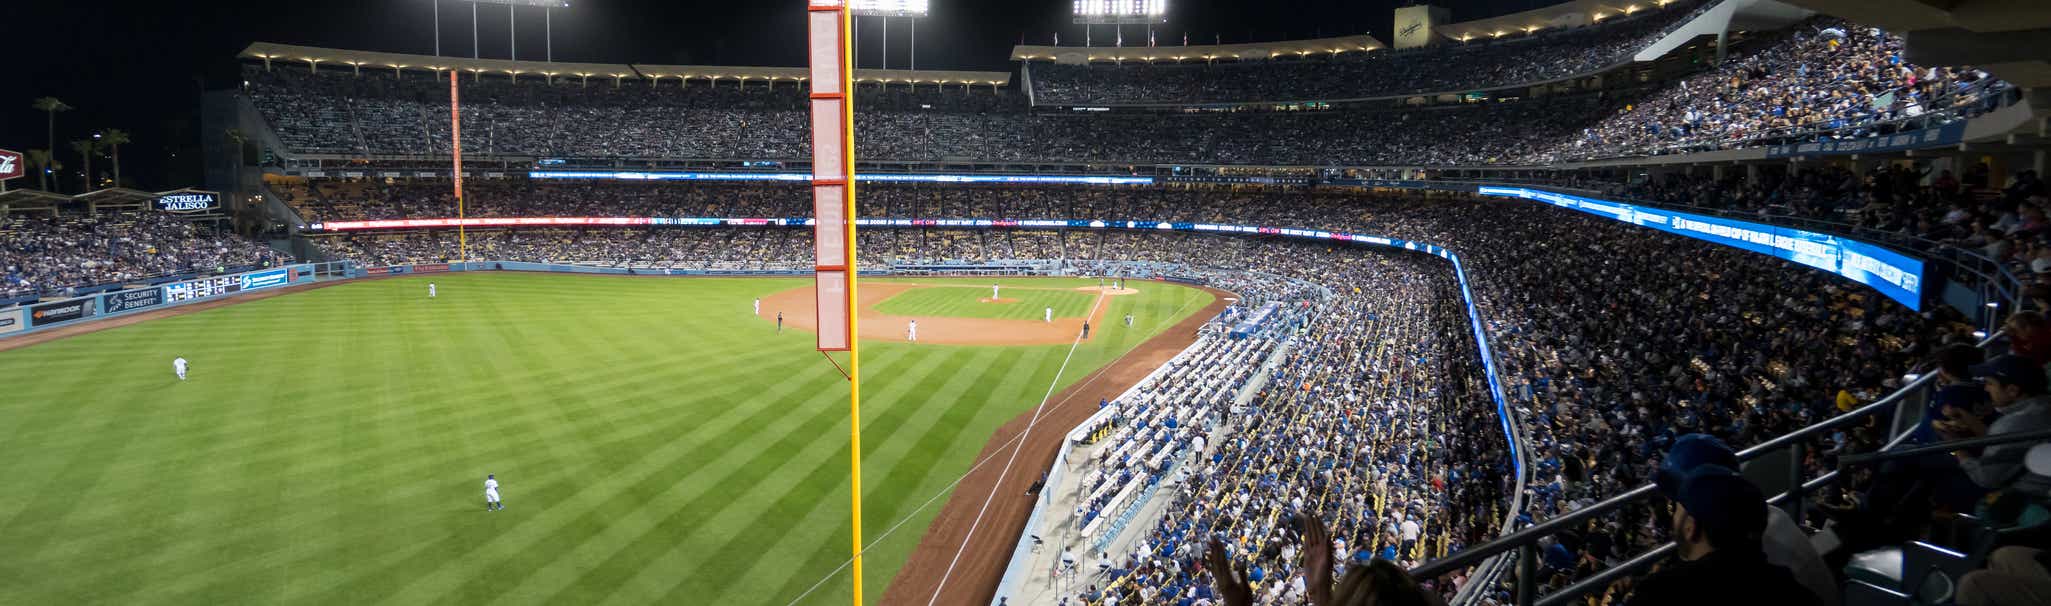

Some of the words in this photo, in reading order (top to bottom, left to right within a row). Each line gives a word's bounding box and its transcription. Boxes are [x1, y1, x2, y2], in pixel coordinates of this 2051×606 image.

[160, 195, 213, 204] ESTRELLA
[165, 202, 208, 210] JALISCO
[124, 289, 158, 300] SECURITY
[124, 299, 155, 309] BENEFIT
